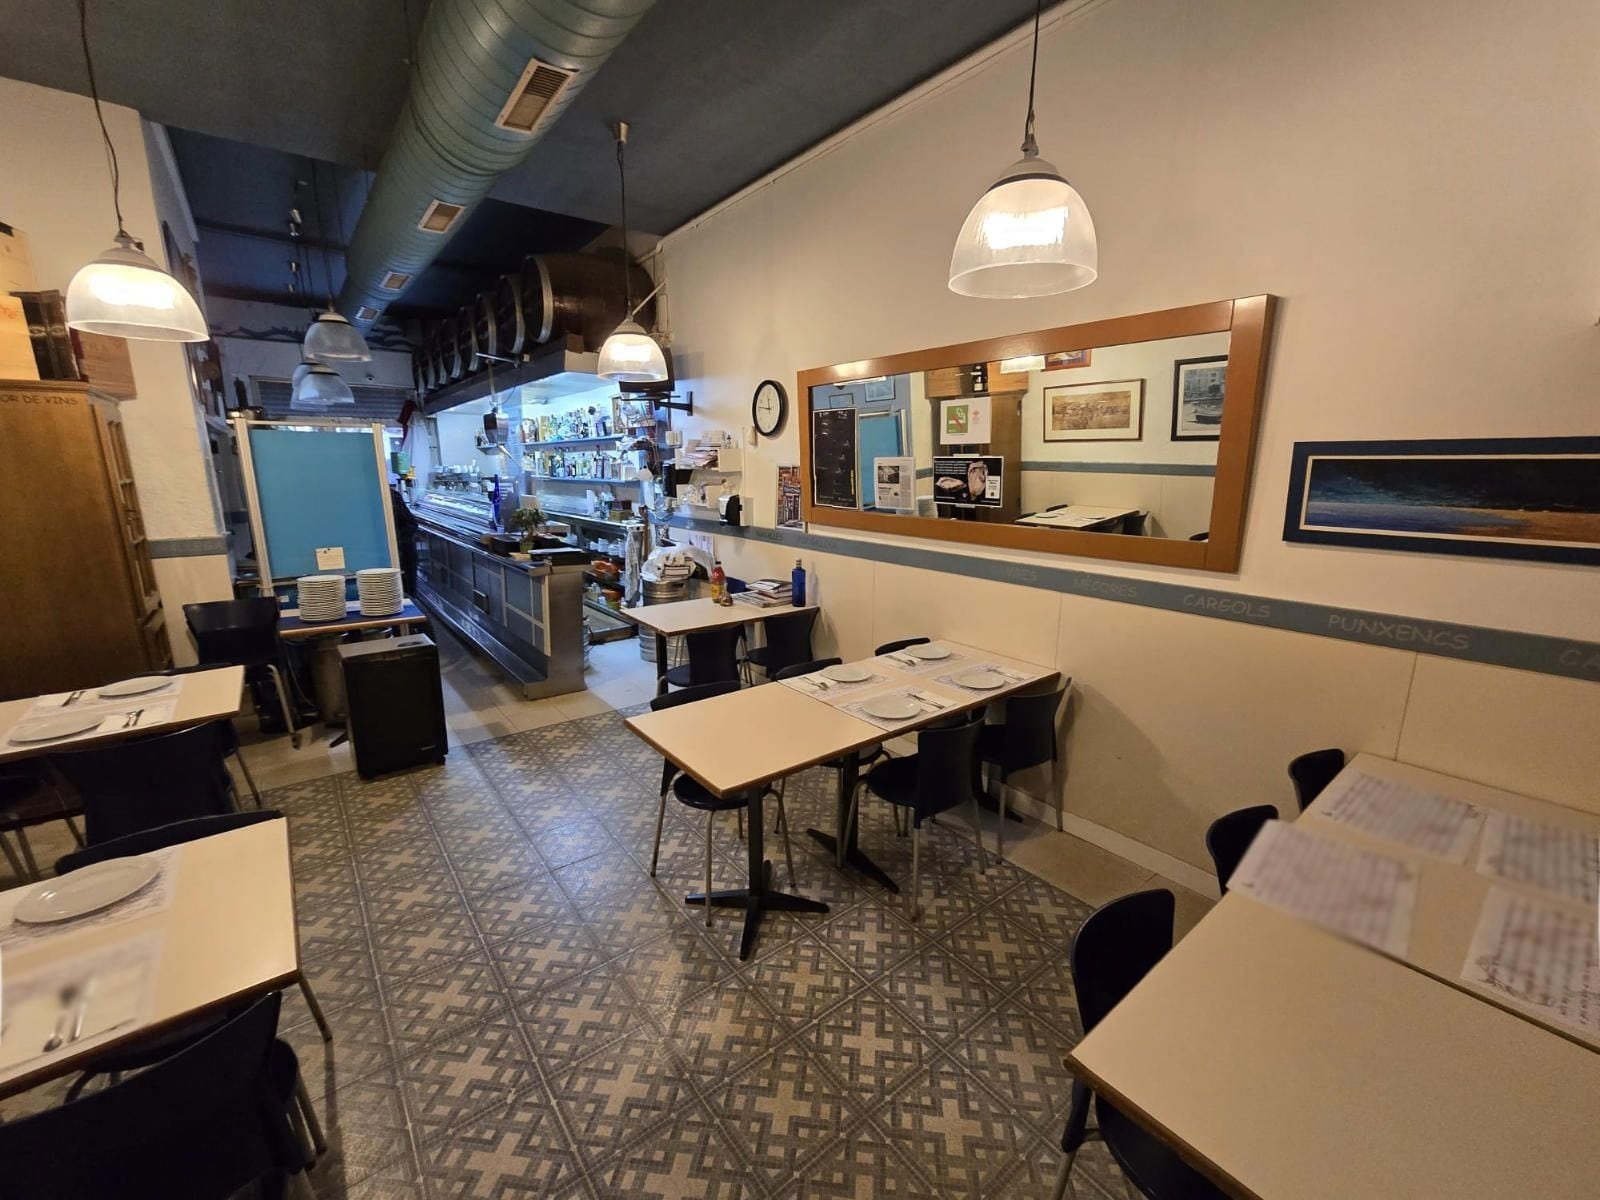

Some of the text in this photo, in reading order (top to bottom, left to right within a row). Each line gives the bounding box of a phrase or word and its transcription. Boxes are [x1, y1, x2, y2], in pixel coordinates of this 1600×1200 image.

[23, 395, 41, 404] DE
[45, 396, 79, 405] VINS
[1183, 593, 1272, 618] CARGOLS
[1328, 614, 1470, 650] PUNXENCS
